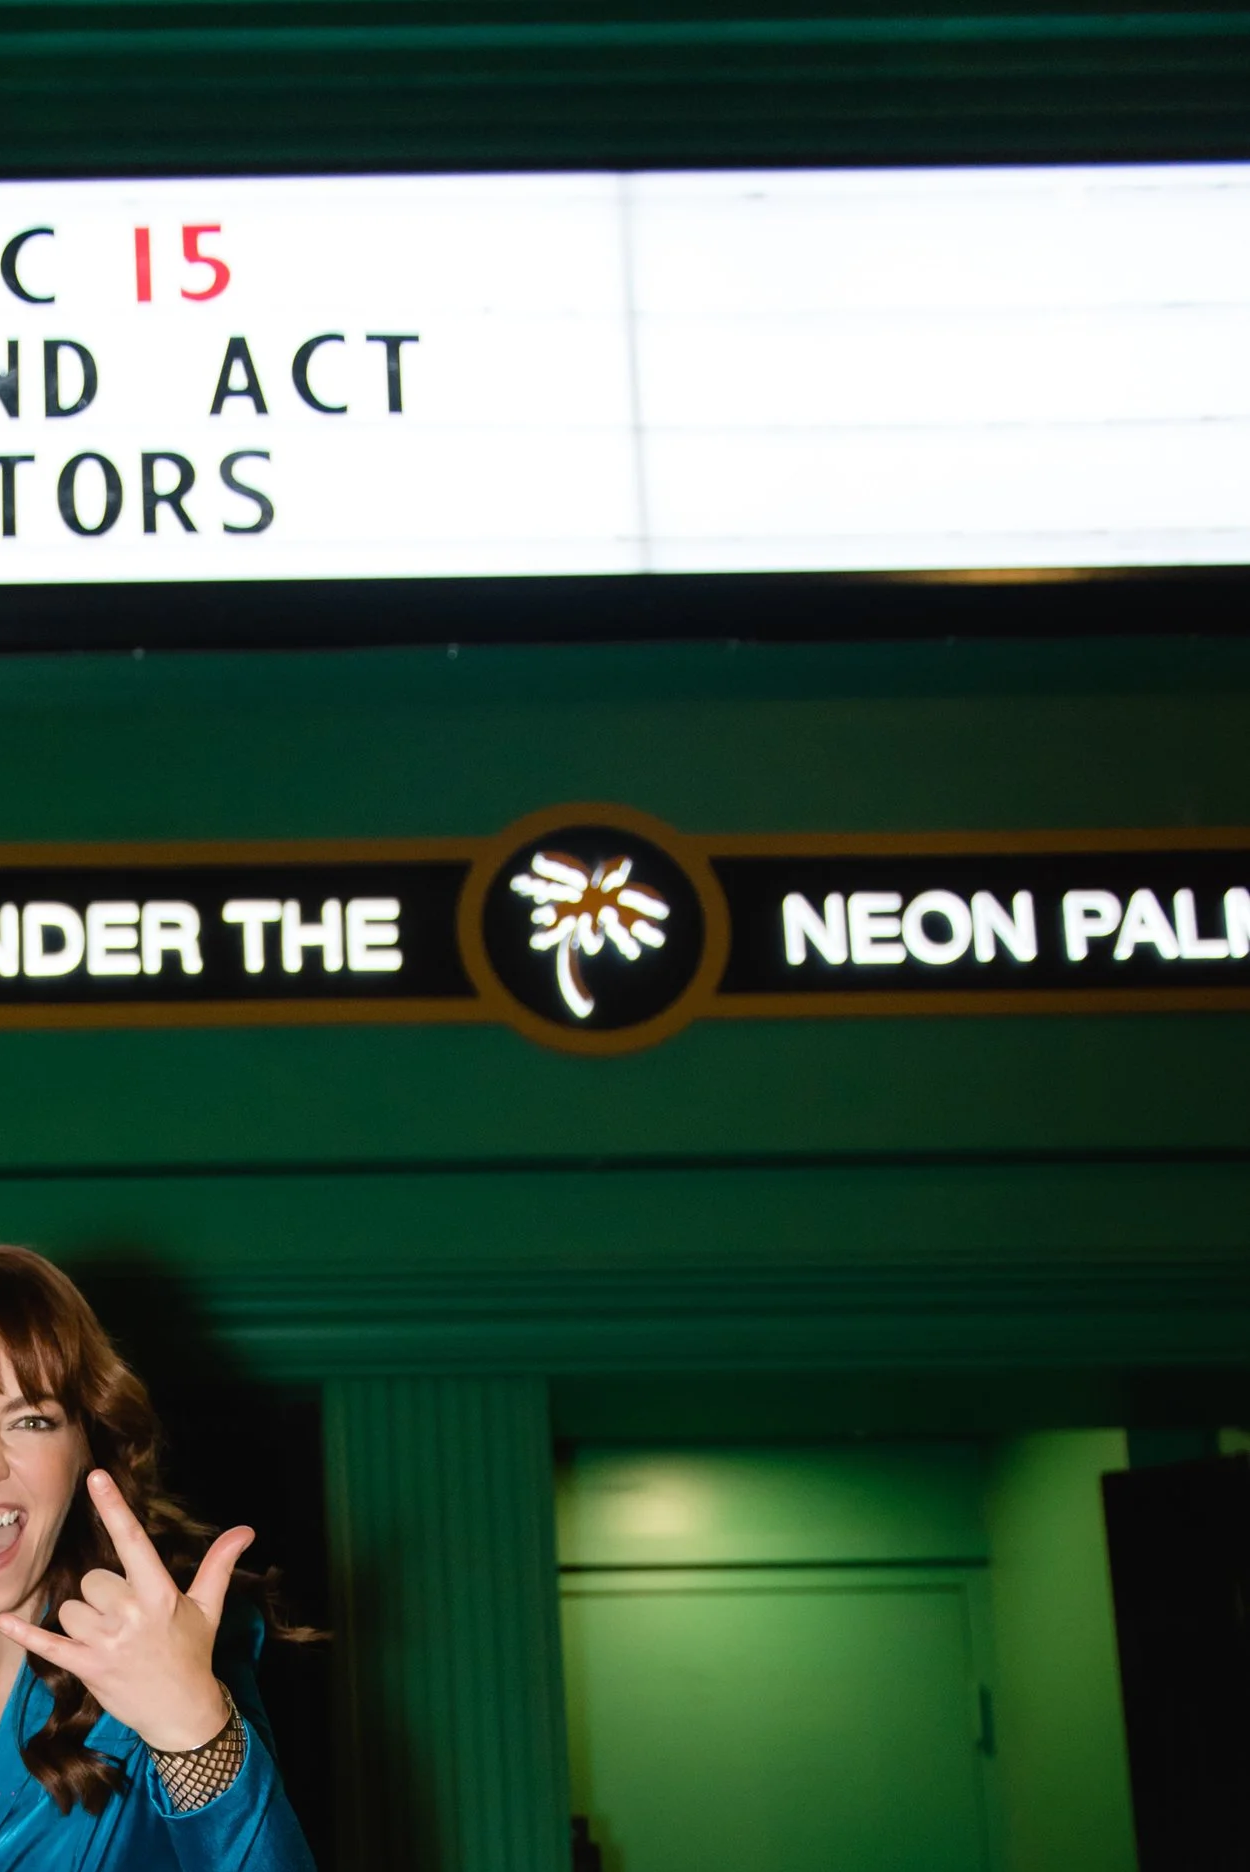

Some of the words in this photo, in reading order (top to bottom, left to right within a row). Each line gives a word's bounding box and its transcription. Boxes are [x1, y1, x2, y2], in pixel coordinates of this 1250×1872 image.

[134, 224, 231, 302] 15
[209, 333, 420, 415] ACT
[222, 898, 403, 974] THE
[782, 889, 1038, 966] NEON
